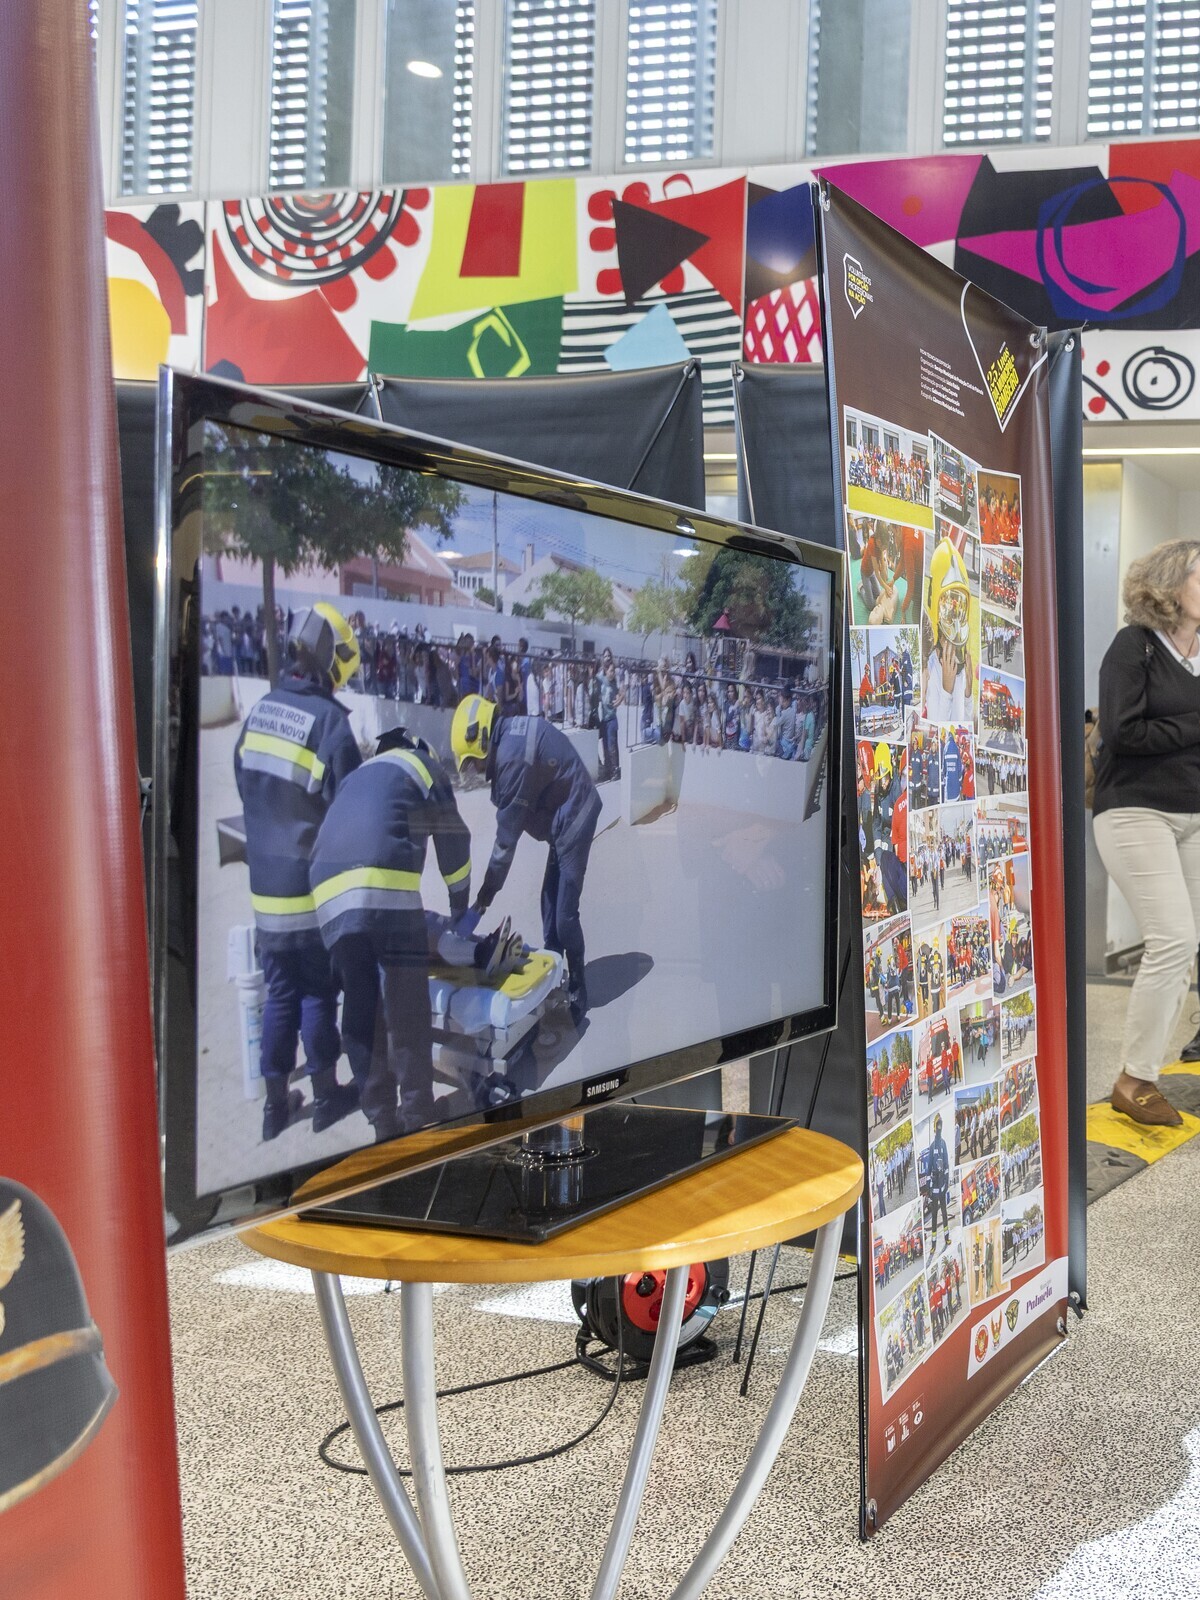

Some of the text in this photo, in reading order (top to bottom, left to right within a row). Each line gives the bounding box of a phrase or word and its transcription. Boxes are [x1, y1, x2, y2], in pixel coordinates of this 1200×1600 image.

[259, 703, 307, 725] BOMBEIROS
[251, 716, 306, 741] PINHAL NOVO
[587, 1078, 620, 1097] SAMSUNG
[1026, 1286, 1053, 1314] Palmela
